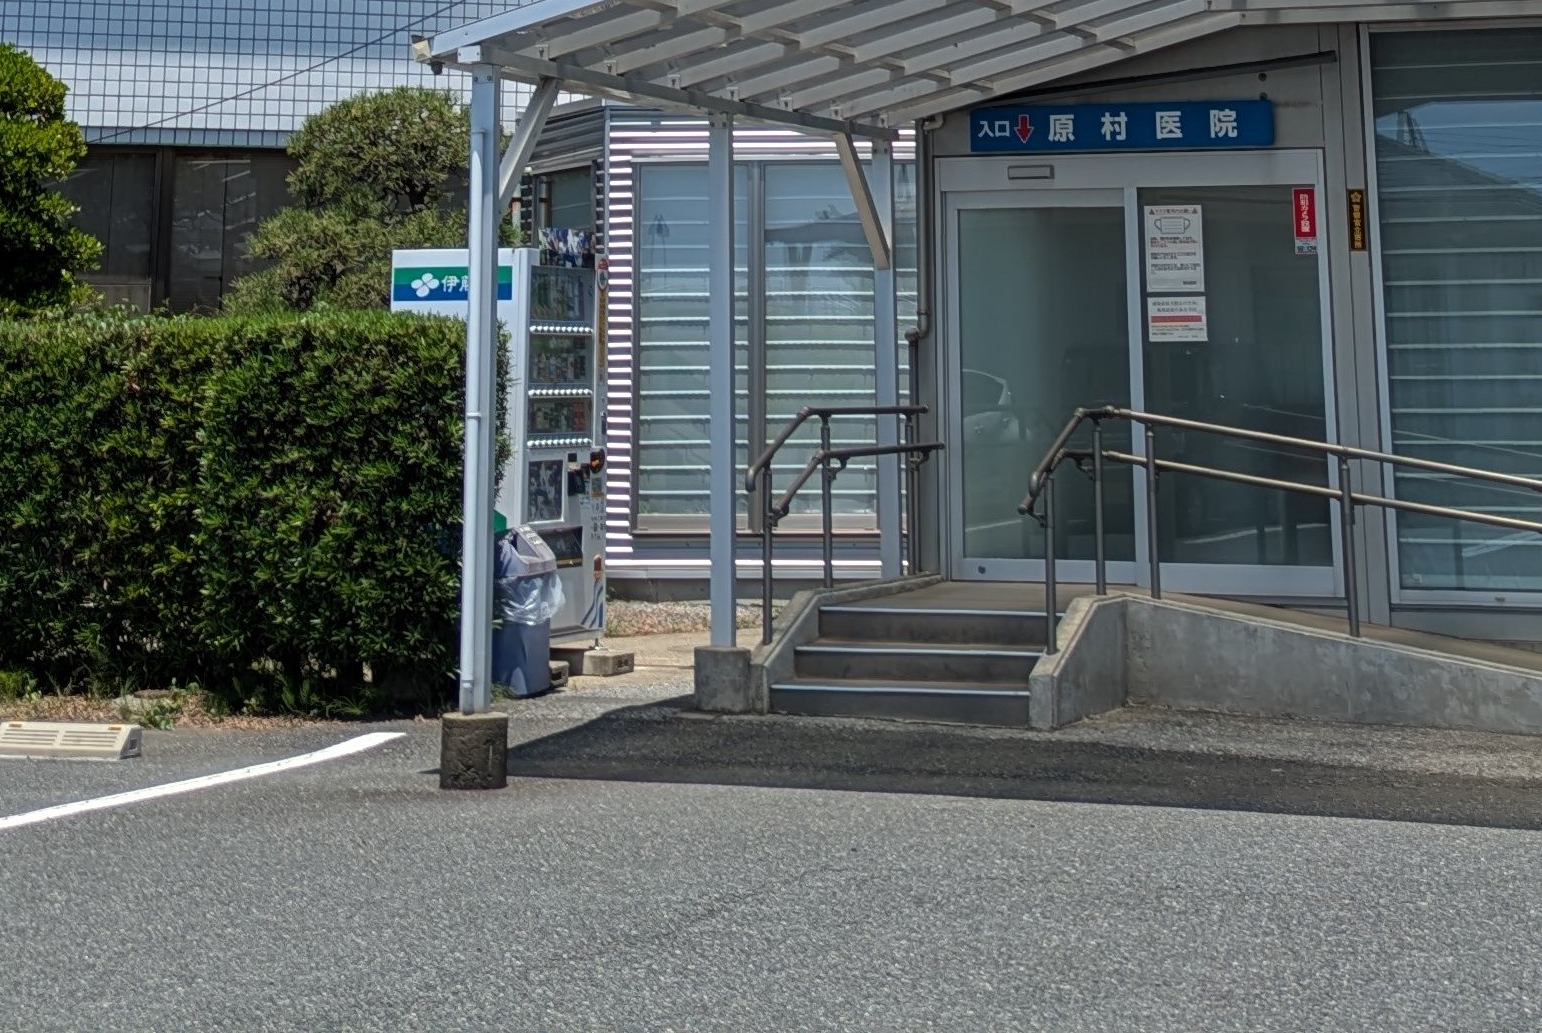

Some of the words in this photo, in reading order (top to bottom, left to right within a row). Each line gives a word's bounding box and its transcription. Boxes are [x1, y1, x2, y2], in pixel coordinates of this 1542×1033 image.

[978, 120, 1010, 138] 入口
[1047, 108, 1238, 143] 原村医院
